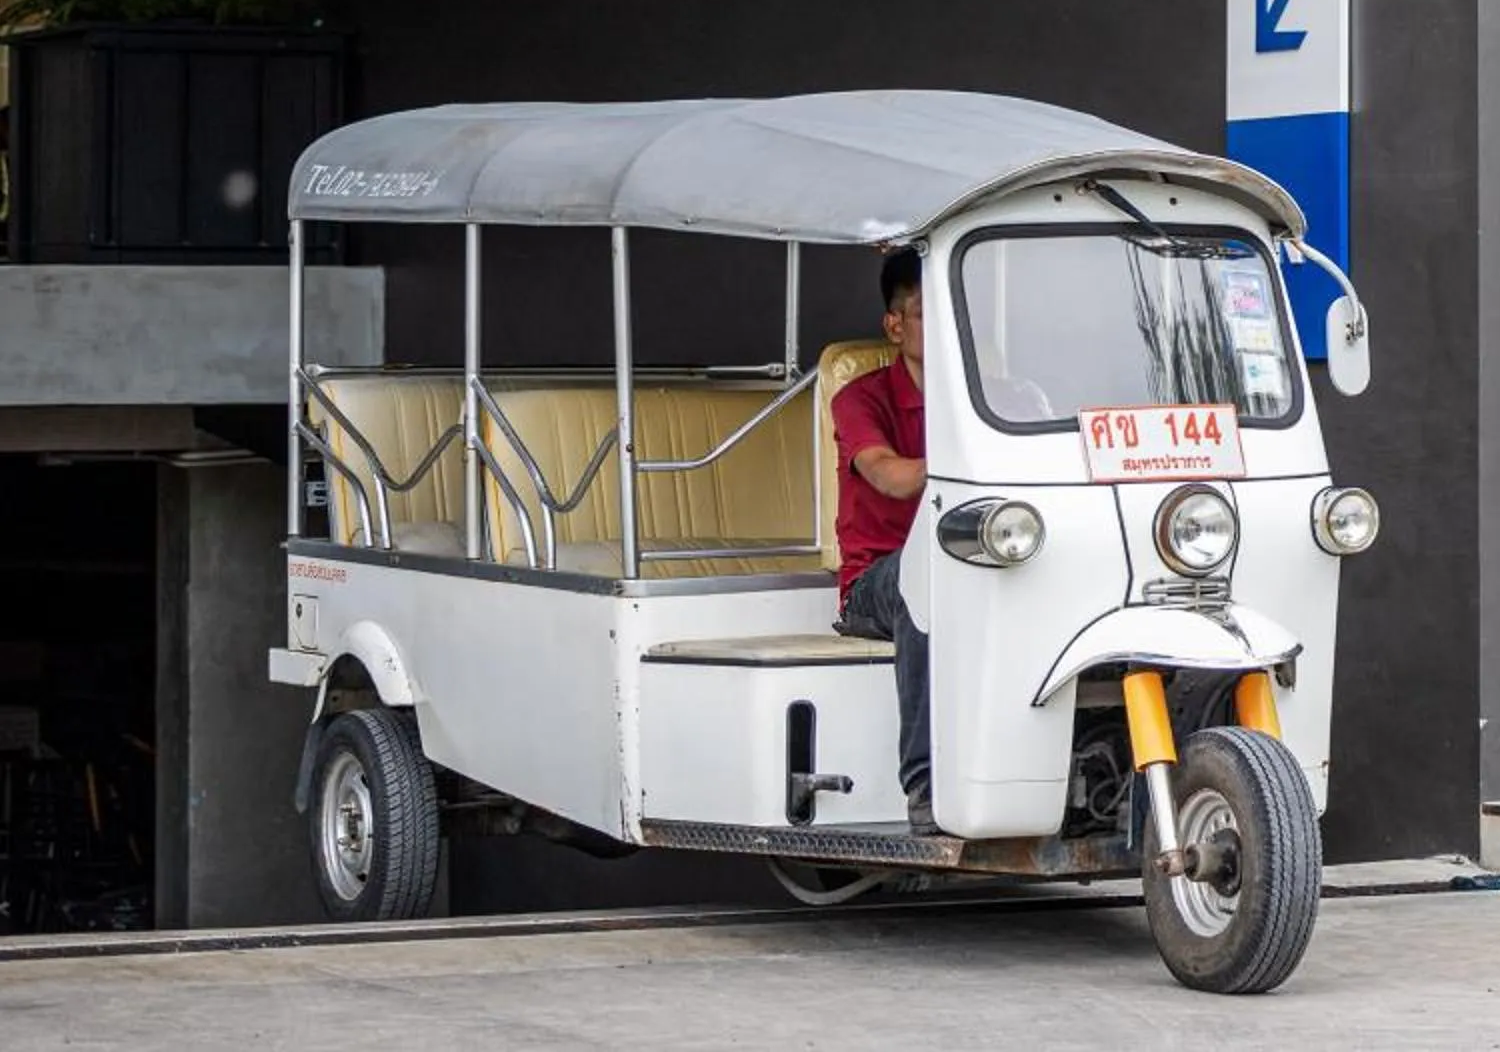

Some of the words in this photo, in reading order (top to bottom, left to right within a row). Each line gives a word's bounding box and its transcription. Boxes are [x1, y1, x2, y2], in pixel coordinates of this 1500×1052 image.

[1090, 412, 1139, 449] ศข
[1164, 411, 1222, 447] 144
[1122, 453, 1212, 475] สมุทรปราการ
